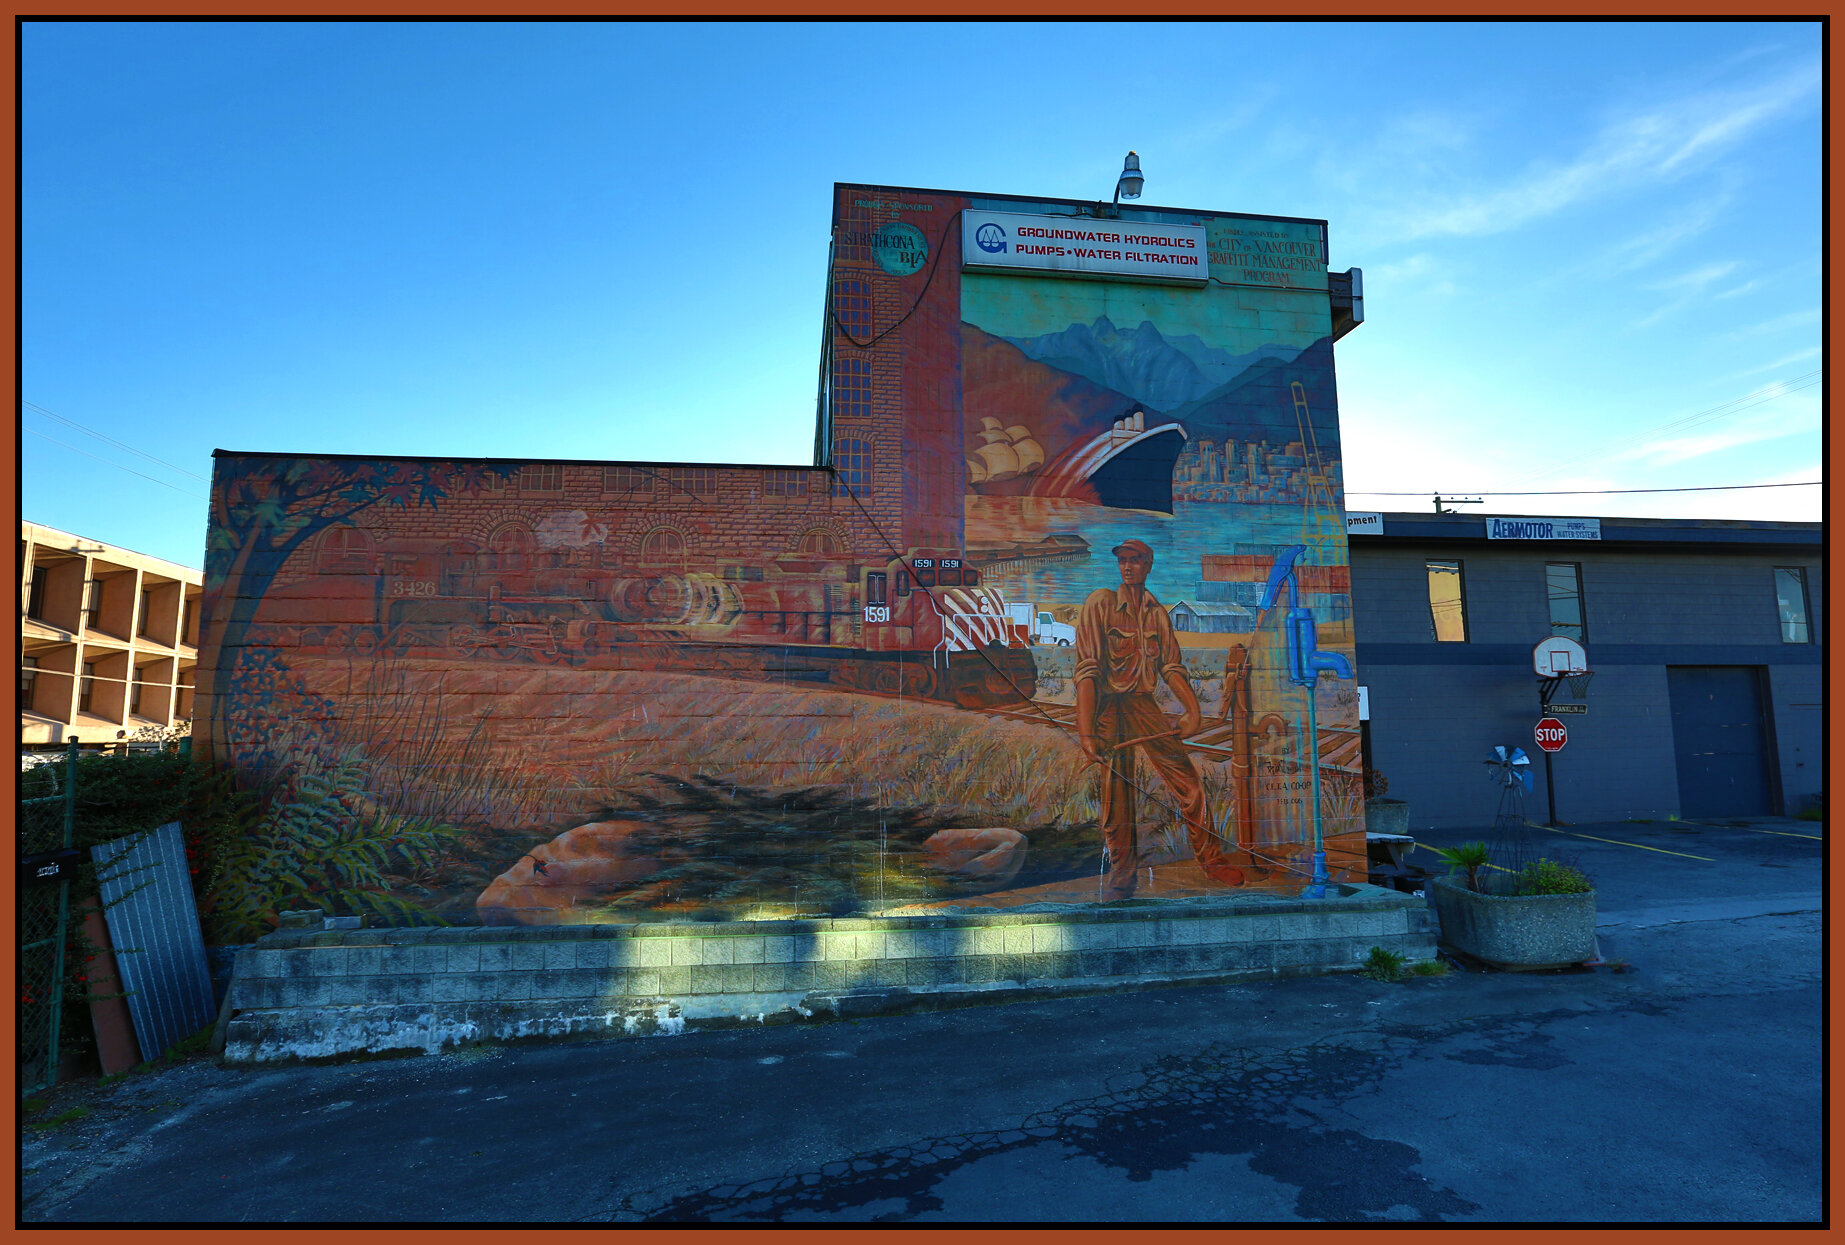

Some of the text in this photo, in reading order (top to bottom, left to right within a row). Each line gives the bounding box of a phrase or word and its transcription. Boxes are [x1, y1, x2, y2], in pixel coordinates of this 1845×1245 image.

[845, 232, 916, 249] STRATHCONA
[1017, 227, 1196, 249] GROUNDWATER HYDROLICS
[1016, 244, 1199, 266] PUMPS WATER FILTRATION
[1219, 238, 1241, 251] CITY
[1254, 240, 1317, 257] VANCOUVER
[899, 250, 929, 269] BIA
[1252, 255, 1323, 272] MANAGEMENT
[1243, 269, 1290, 283] PROGRAM
[1492, 519, 1553, 539] AERMOTOR
[1576, 530, 1599, 540] SYSTEMS
[914, 559, 932, 568] 1591
[941, 559, 959, 568] 1591
[393, 581, 436, 596] 3426
[863, 606, 890, 623] 1591
[1551, 705, 1578, 713] FRANKLIN
[1536, 728, 1565, 742] STOP
